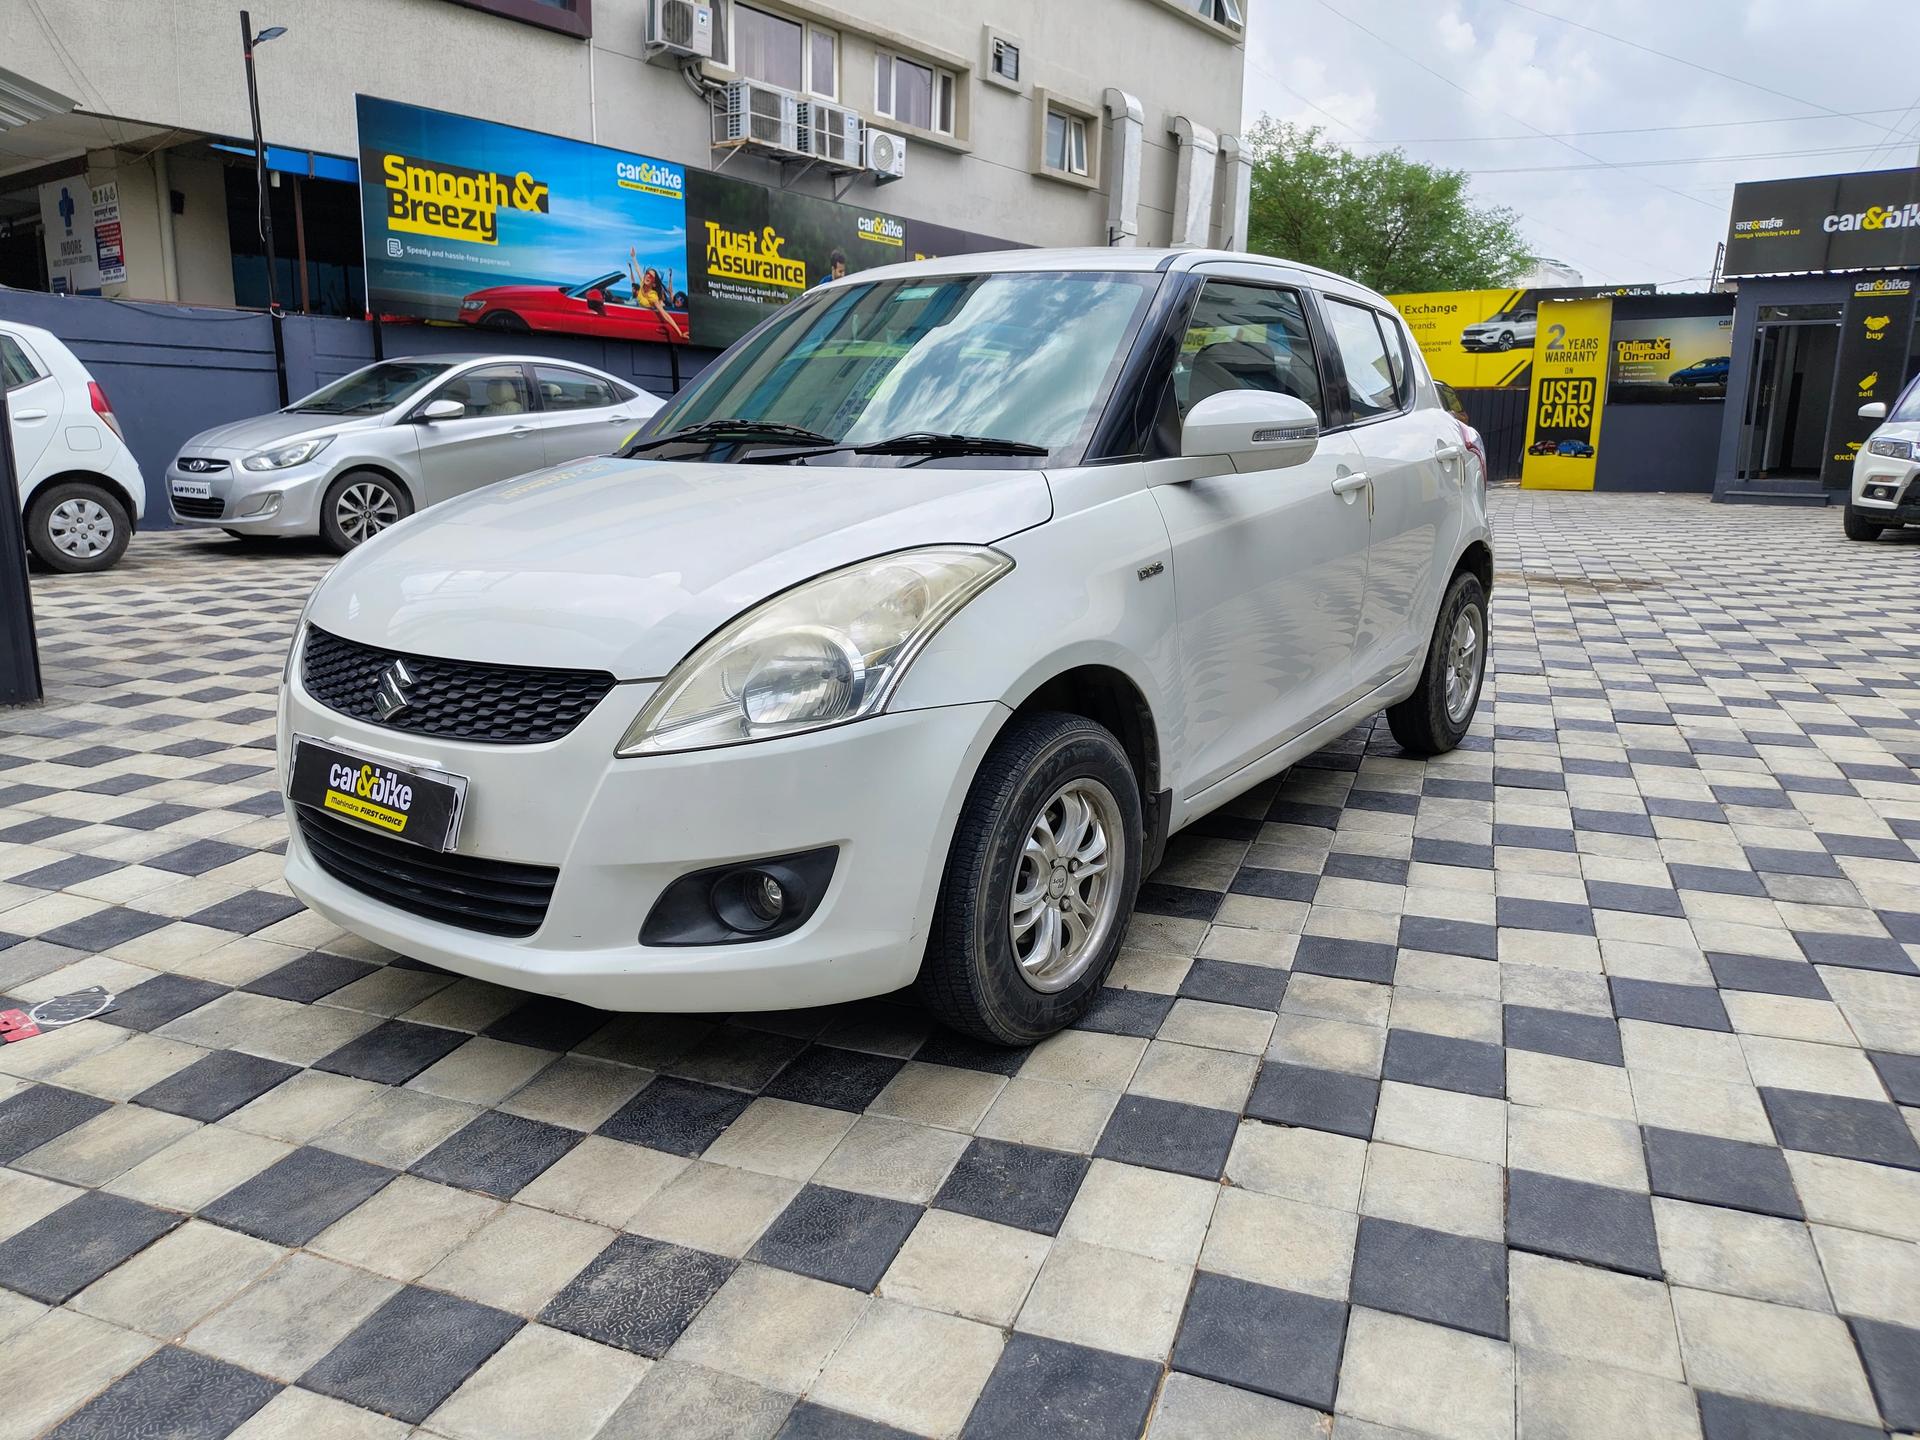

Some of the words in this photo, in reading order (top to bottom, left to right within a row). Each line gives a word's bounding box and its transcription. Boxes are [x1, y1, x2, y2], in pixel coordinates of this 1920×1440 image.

[383, 154, 508, 208] Smooth
[616, 162, 682, 189] car&bike
[387, 189, 497, 242] Breezy
[1823, 203, 1920, 232] car&bik
[705, 221, 757, 254] Trust
[857, 217, 903, 238] car&bike
[407, 246, 431, 258] Speedy
[432, 250, 444, 258] and
[707, 247, 804, 284] Assurance
[722, 283, 735, 291] loved
[748, 286, 757, 294] Car
[757, 288, 771, 297] brand
[1855, 279, 1911, 291] car&bike
[1404, 304, 1458, 314] Exchange
[1408, 321, 1437, 329] brands
[1546, 323, 1566, 350] 2
[1568, 338, 1599, 350] YEARS
[1617, 340, 1652, 351] Online
[1865, 331, 1884, 341] buy
[1545, 350, 1598, 363] WARRANTY
[1623, 350, 1671, 361] On-road
[1541, 380, 1593, 404] USED
[1539, 404, 1591, 428] CARS
[1833, 453, 1856, 461] exch
[329, 763, 413, 811] car&bike
[360, 807, 380, 818] FIRST
[378, 813, 403, 827] CHOICE
